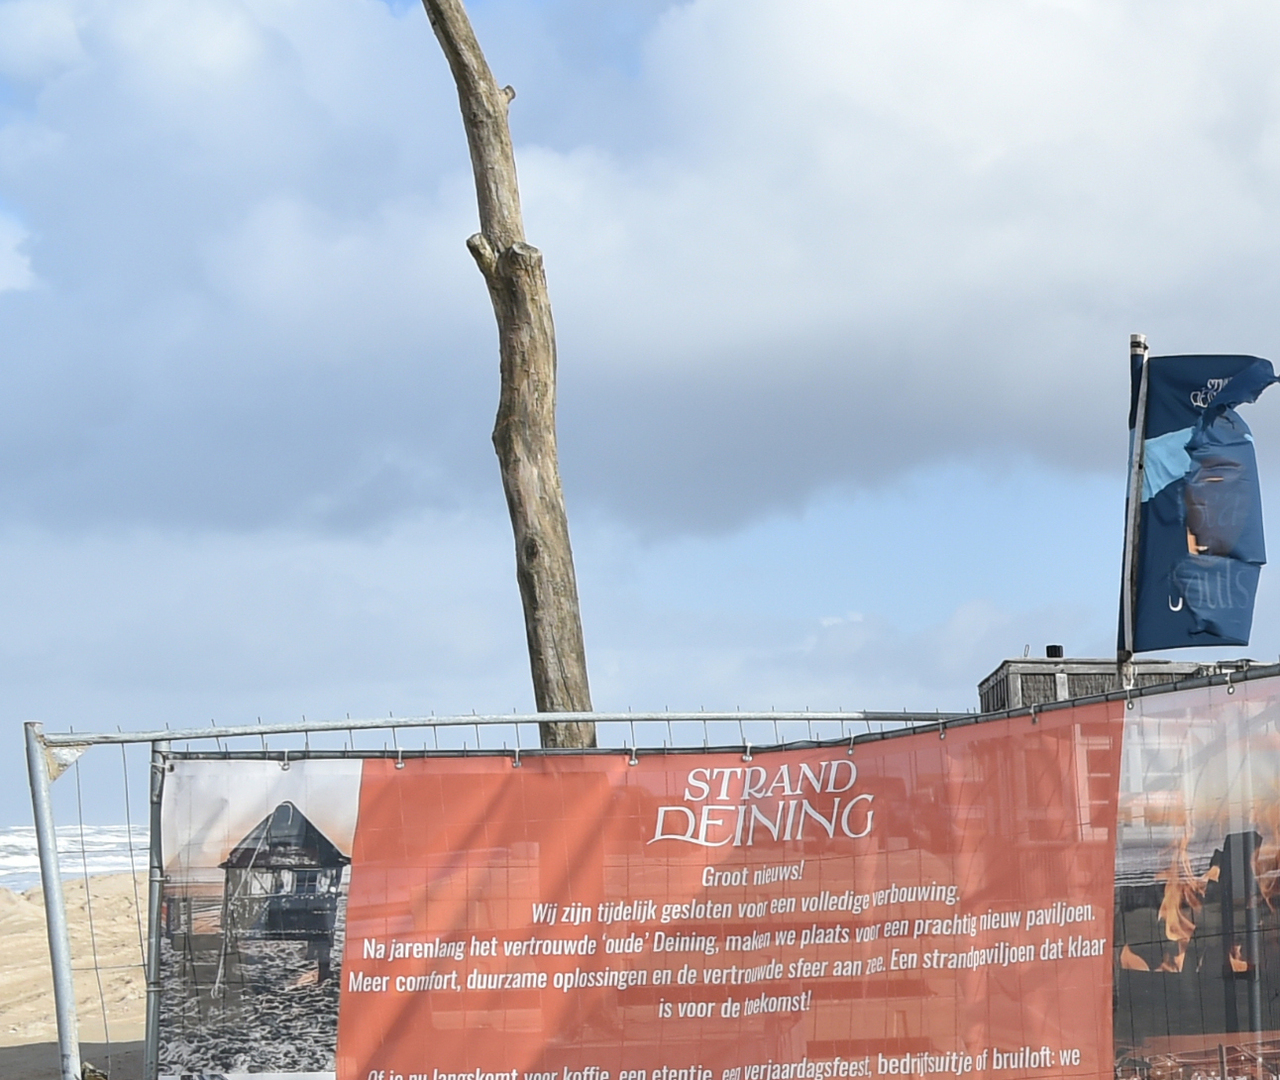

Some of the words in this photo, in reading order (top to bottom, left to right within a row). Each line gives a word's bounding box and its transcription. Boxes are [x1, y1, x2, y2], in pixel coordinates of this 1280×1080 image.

[684, 759, 857, 801] STRAND
[646, 794, 874, 847] DEINING
[702, 866, 748, 887] Groot
[754, 860, 805, 885] nieuws!
[532, 902, 557, 925] Wij
[561, 903, 592, 924] zijn
[598, 900, 657, 924] tijdelijk
[661, 899, 732, 923] gesloten
[738, 899, 768, 918] voor
[771, 896, 796, 914] een
[801, 892, 869, 914] volledige
[872, 881, 960, 906] verbouwing.
[363, 939, 385, 959] Na
[388, 938, 466, 961] jarenlang
[470, 936, 497, 957] het
[503, 934, 596, 956] vertrouwde
[653, 931, 719, 955] Deining,
[726, 924, 770, 951] maken
[775, 929, 796, 946] we
[801, 924, 849, 949] plaats
[855, 922, 880, 943] voor
[884, 918, 908, 938] een
[914, 913, 977, 938] prachtig
[980, 908, 1021, 931] nieuw
[1026, 902, 1095, 931] paviljoen.
[349, 971, 389, 992] Meer
[396, 971, 461, 992] comfort,
[467, 970, 547, 990] duurzame
[553, 968, 647, 992] oplossingen
[652, 968, 672, 985] en
[678, 965, 696, 984] de
[702, 958, 783, 985] vertrouwde
[788, 957, 826, 978] sfeer
[832, 959, 862, 977] aan
[866, 956, 886, 975] zee.
[890, 949, 918, 971] Een
[922, 942, 1035, 971] strandpaviljoen
[1040, 938, 1064, 960] dat
[1068, 936, 1107, 957] klaar
[659, 999, 672, 1018] is
[678, 1000, 715, 1018] voor
[721, 999, 740, 1018] de
[744, 990, 812, 1017] toekomst!
[877, 1049, 972, 1077] bedrijfsuitje
[976, 1049, 988, 1071] of
[992, 1046, 1055, 1070] bruiloft:
[1060, 1048, 1080, 1066] we
